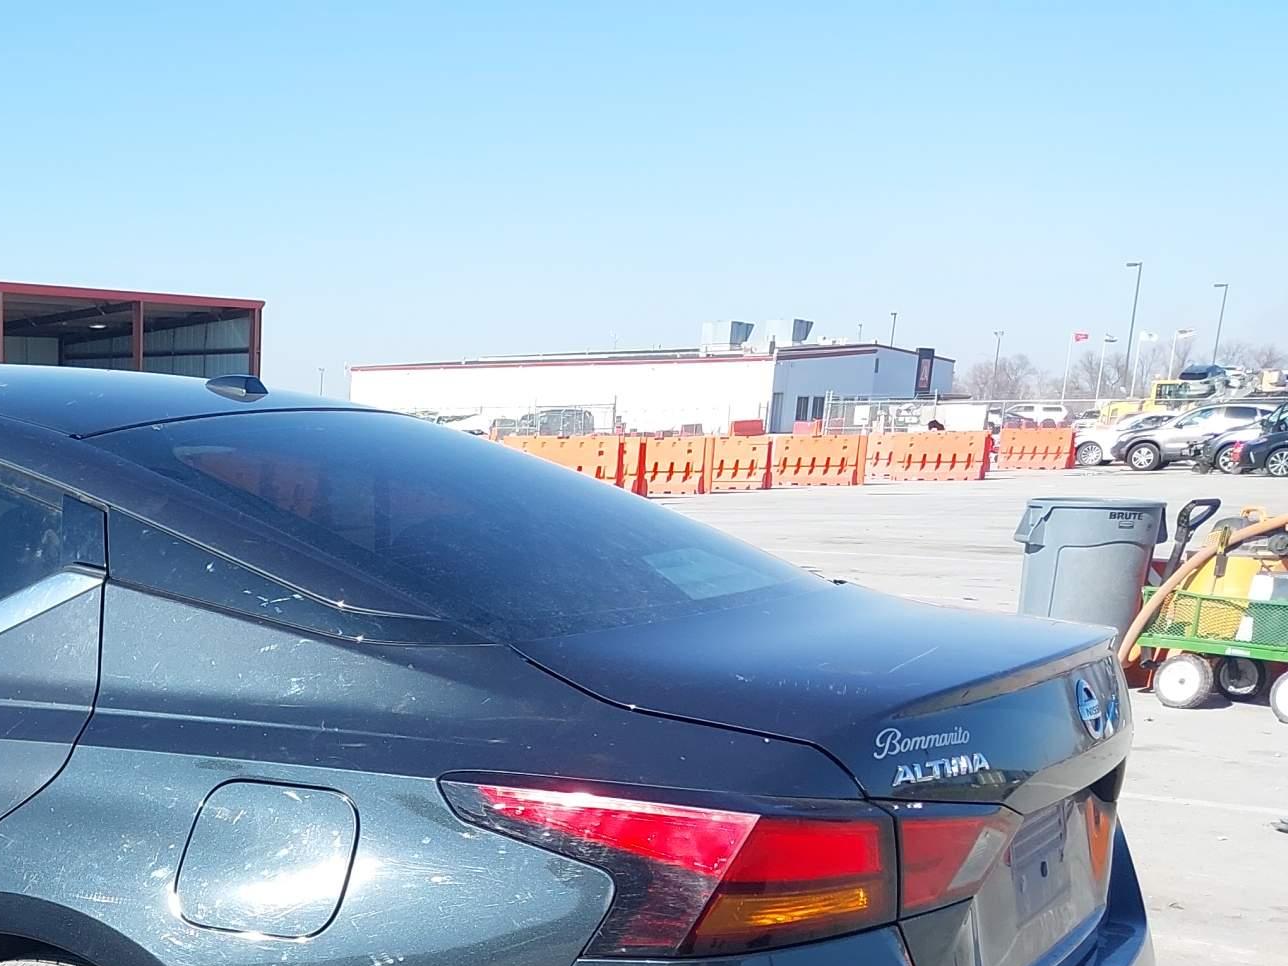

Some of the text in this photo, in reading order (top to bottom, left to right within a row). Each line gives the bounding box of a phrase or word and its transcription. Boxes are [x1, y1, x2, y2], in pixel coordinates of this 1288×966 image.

[1109, 511, 1144, 521] BRUTE
[873, 726, 970, 760] Bommarito
[892, 752, 990, 787] ALTIMA
